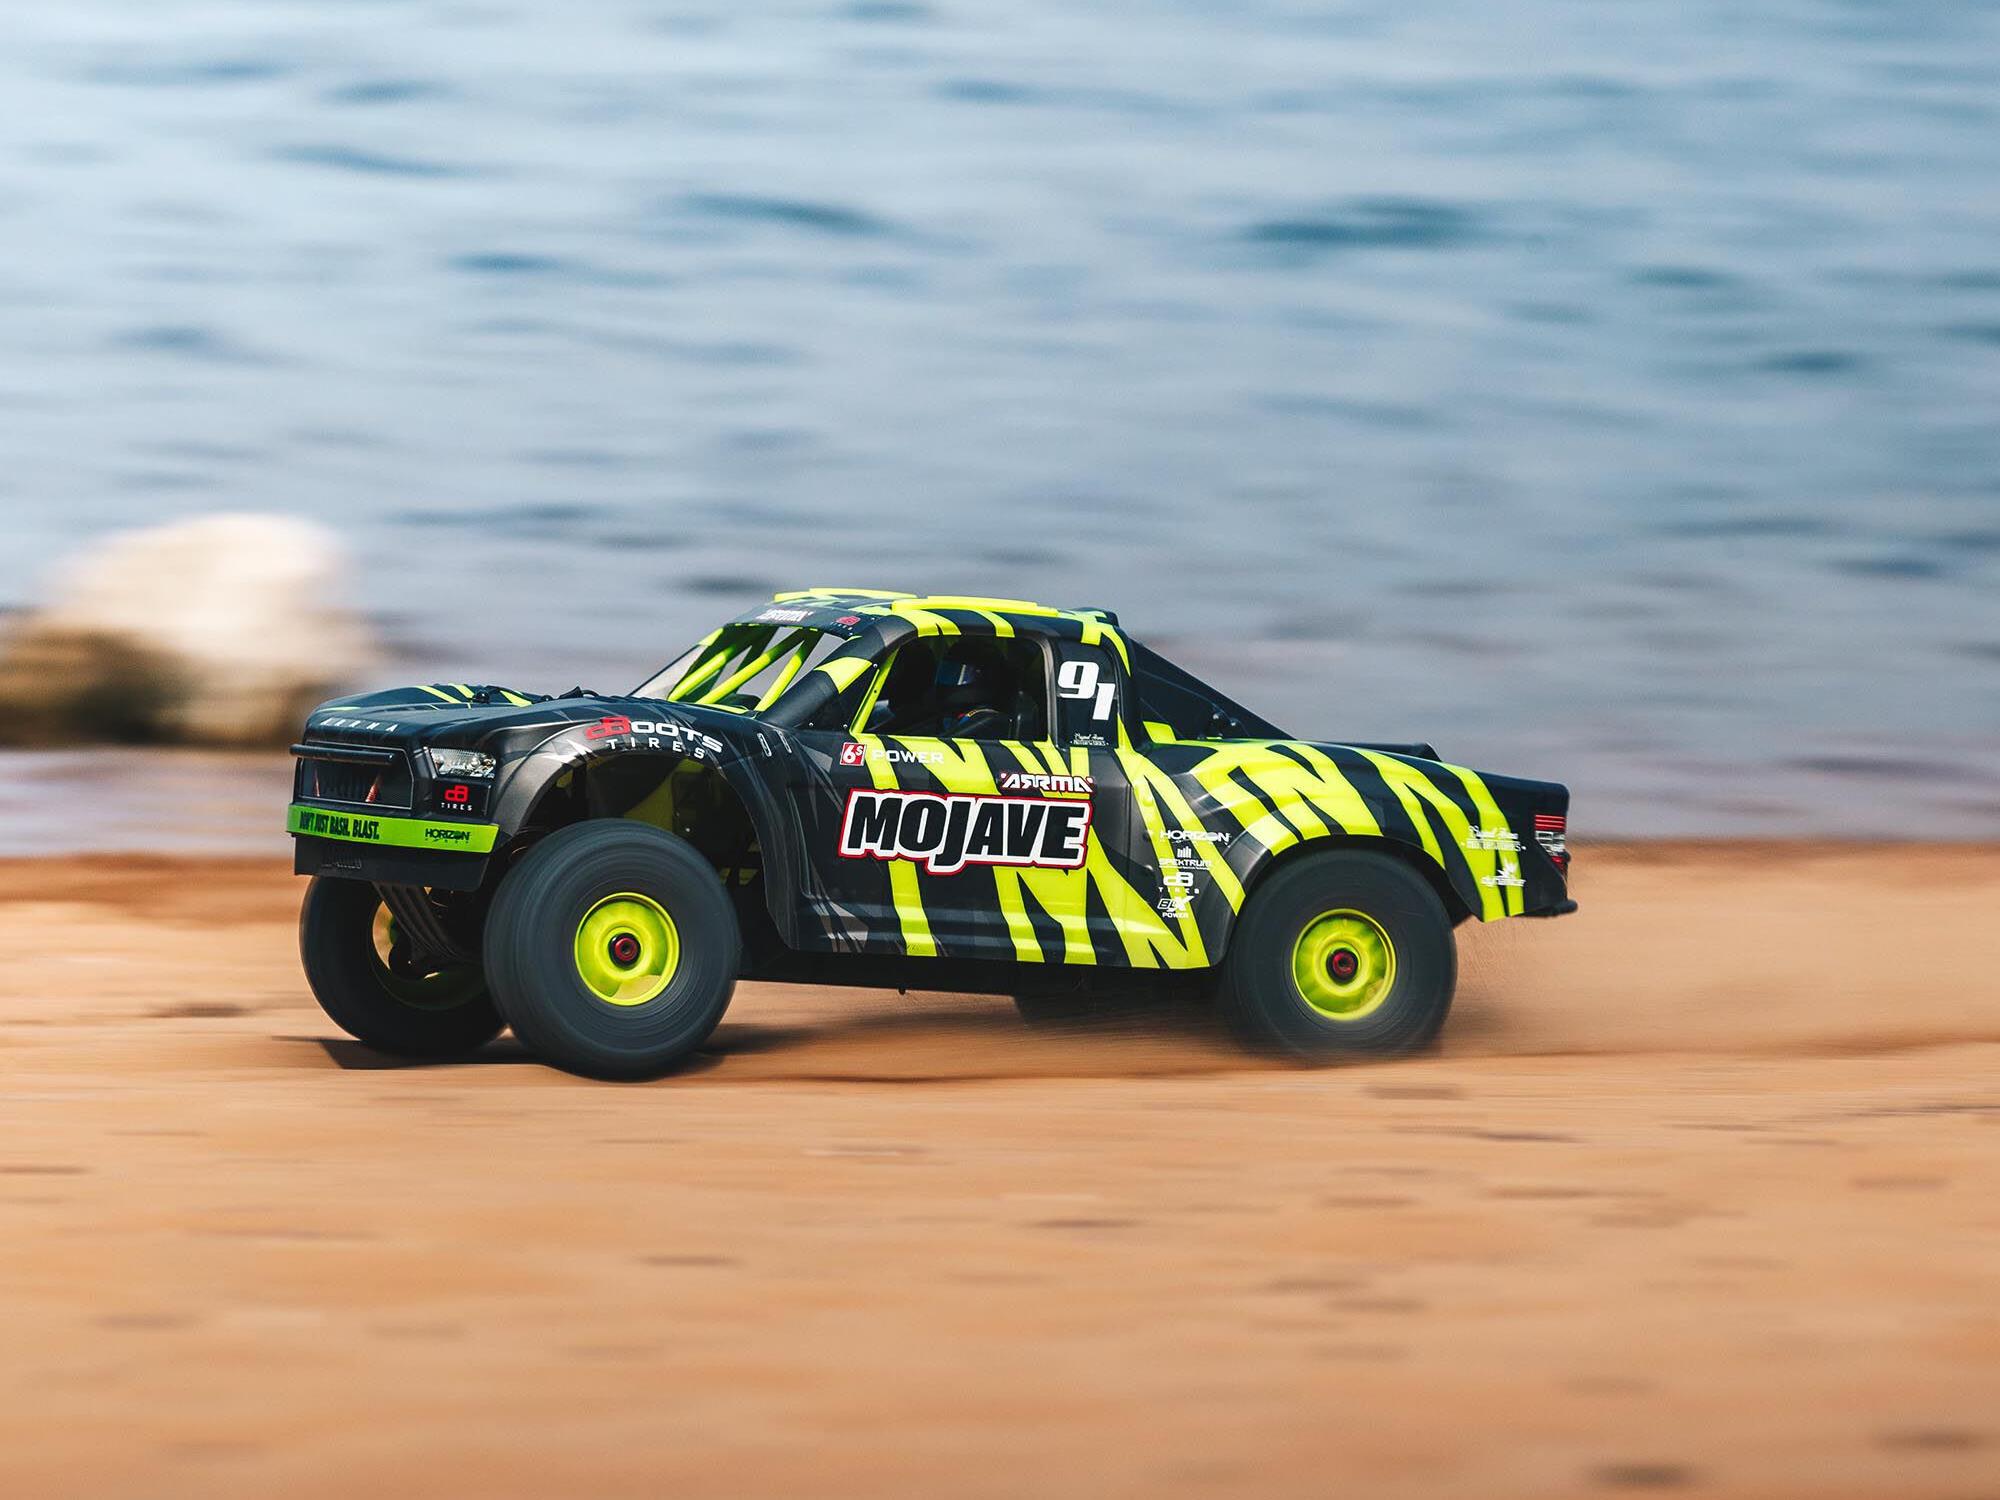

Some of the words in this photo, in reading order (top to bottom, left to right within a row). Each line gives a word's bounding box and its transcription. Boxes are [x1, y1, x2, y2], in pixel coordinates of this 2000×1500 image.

[1058, 661, 1116, 721] 91
[606, 736, 706, 760] TIRES
[871, 749, 944, 764] POWER
[441, 802, 473, 811] TIRES
[352, 818, 380, 840] BLAST.
[425, 828, 470, 841] HORIZON
[846, 794, 1088, 869] MOJAVE
[1160, 829, 1231, 843] HORIZON
[1158, 886, 1200, 895] TIRES
